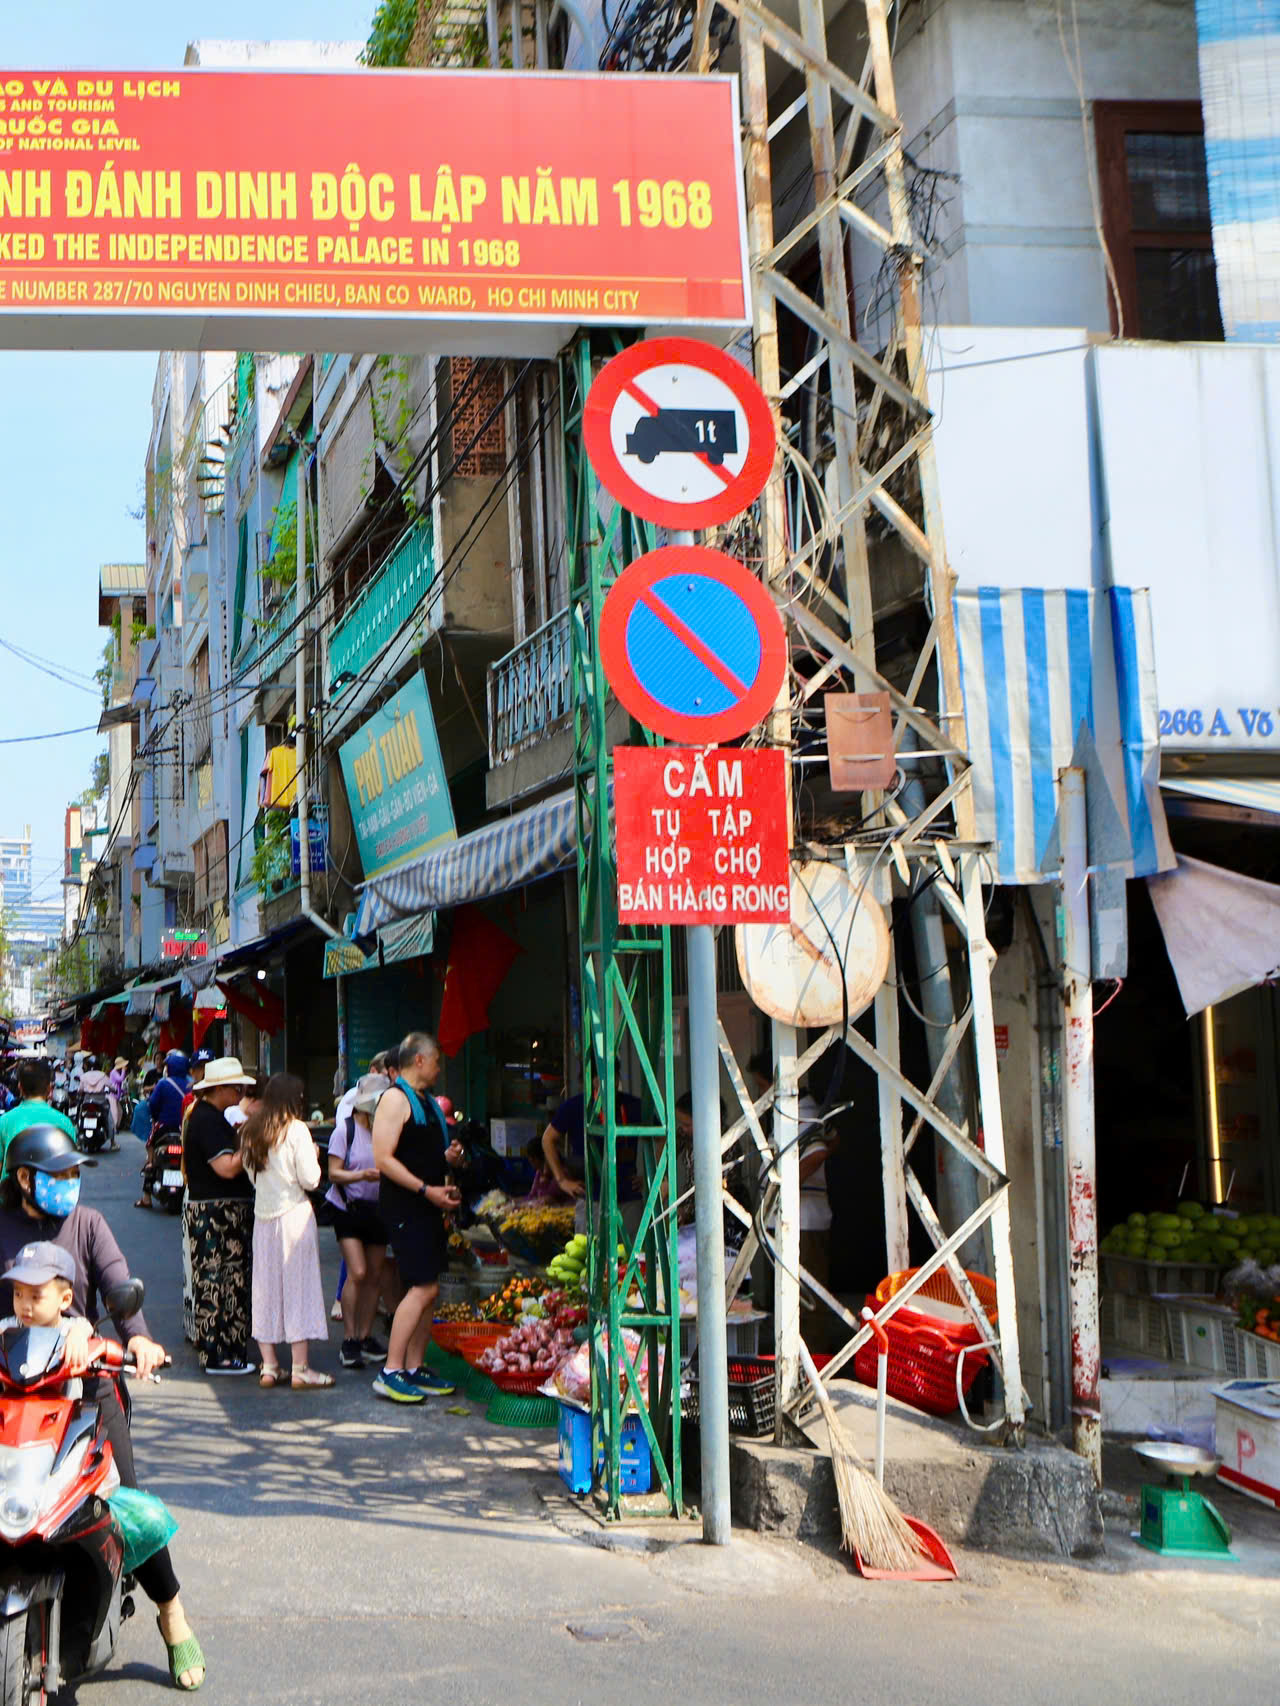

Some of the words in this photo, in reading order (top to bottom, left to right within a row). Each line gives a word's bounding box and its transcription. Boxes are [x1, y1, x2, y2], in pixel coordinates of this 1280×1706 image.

[32, 77, 69, 97] VÀ
[77, 79, 114, 97] DU
[123, 79, 181, 101] LỊCH
[10, 99, 43, 113] AND
[48, 99, 115, 113] TOURISM
[71, 118, 120, 136] GIA
[19, 137, 93, 151] NATIONAL
[98, 137, 140, 151] LEVEL
[65, 161, 181, 219] ĐÁNH
[196, 171, 297, 220] DINH
[310, 163, 395, 231] ĐỘC
[410, 165, 486, 233] LẬP
[501, 167, 599, 226] NĂM
[612, 179, 712, 229] 1968
[53, 233, 100, 260] THE
[109, 233, 308, 263] INDEPENDENCE
[317, 235, 412, 264] PALACE
[422, 238, 448, 265] IN
[459, 239, 520, 267] 1968
[12, 280, 87, 300] NUMBER
[93, 279, 153, 304] 287/70
[158, 281, 231, 302] NGUYEN
[236, 281, 279, 303] DINH
[284, 282, 341, 306] CHIEU,
[345, 283, 381, 305] BAN
[386, 284, 409, 306] CO
[418, 285, 476, 309] WARD,
[488, 286, 513, 308] HO
[518, 286, 546, 308] CHI
[551, 286, 599, 310] MINH
[603, 286, 639, 310] CITY
[695, 419, 717, 446] 1t
[1160, 709, 1204, 736] 266
[1208, 708, 1232, 736] A
[1238, 708, 1274, 736] Võ
[664, 743, 744, 799] CẤM
[652, 809, 681, 841] TỤ
[708, 804, 752, 841] TẬP
[645, 842, 691, 879] HỢP
[714, 842, 762, 879] CHỢ
[619, 877, 664, 911] BÁN
[670, 877, 728, 911] HÀNG
[732, 884, 788, 912] RONG
